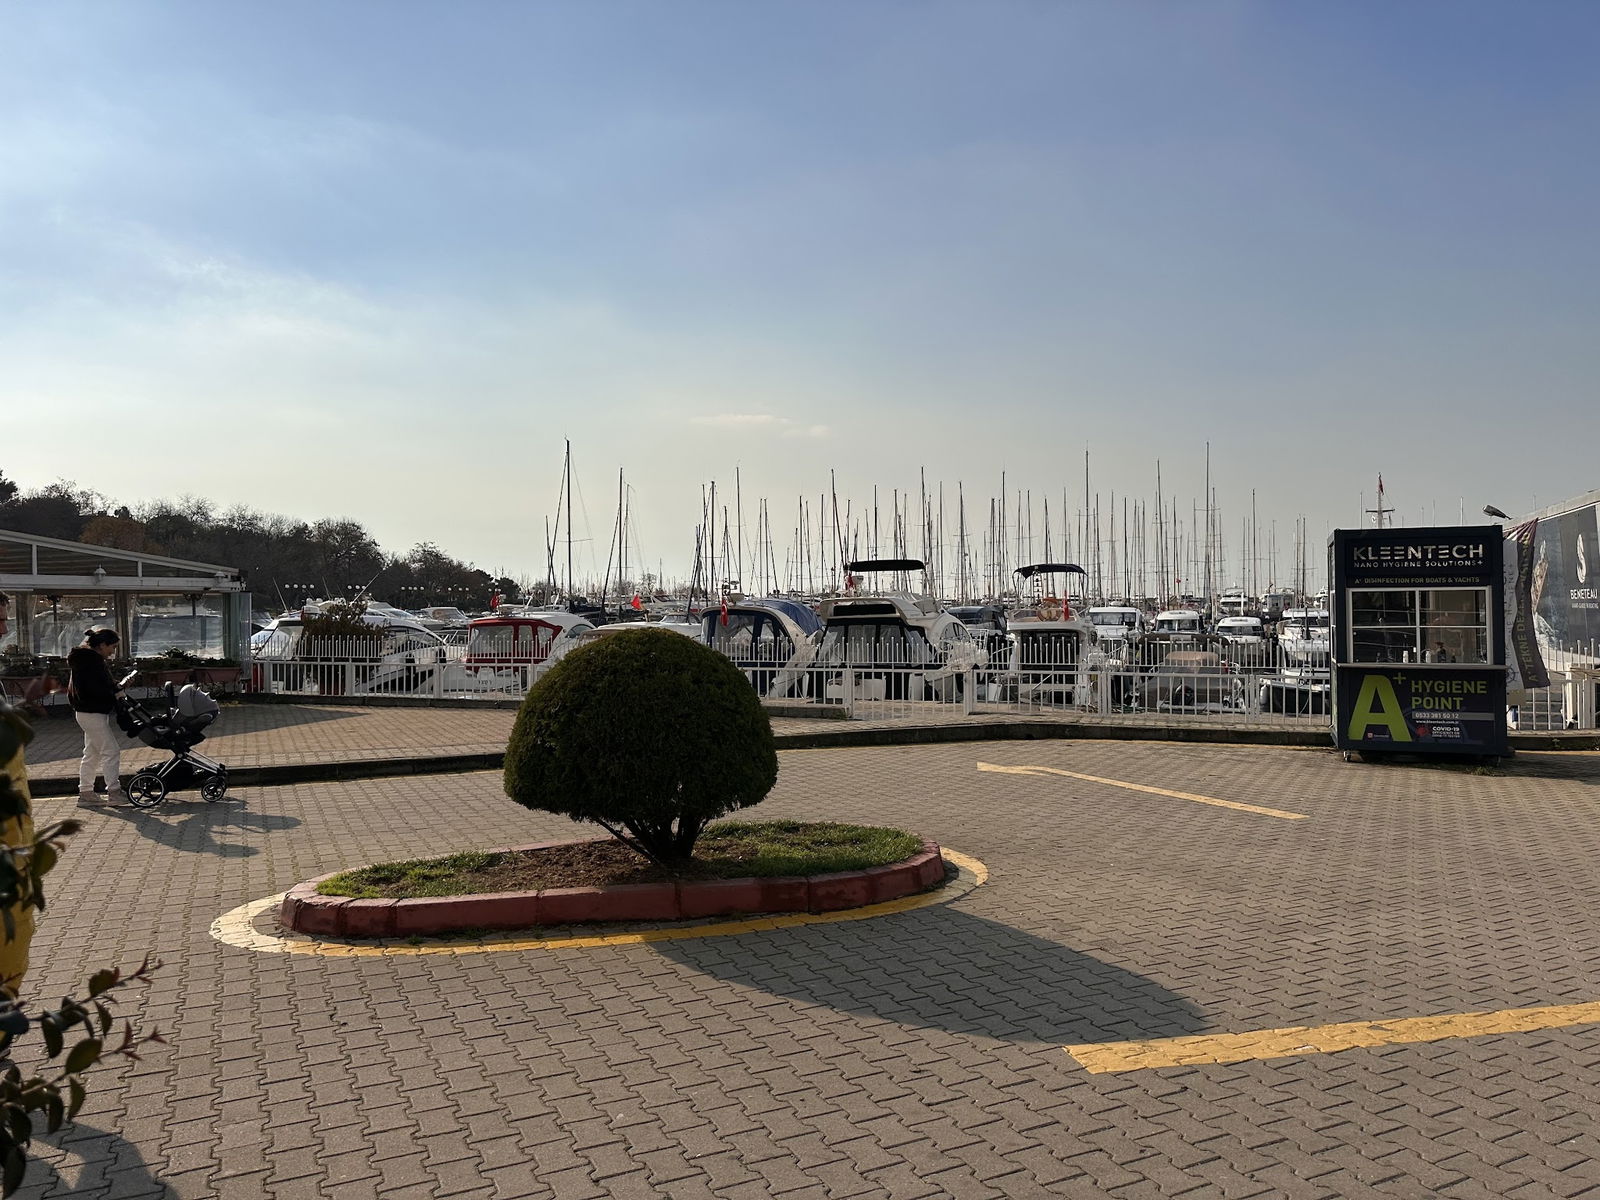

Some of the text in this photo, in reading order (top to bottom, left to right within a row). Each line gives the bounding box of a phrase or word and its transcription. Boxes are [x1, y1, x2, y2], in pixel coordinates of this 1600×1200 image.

[1353, 544, 1483, 560] KLEENTECH
[1569, 588, 1598, 600] BENETEAU
[1517, 635, 1531, 670] TEKNE
[1411, 680, 1487, 693] HYGIENE
[1412, 697, 1463, 709] POINT
